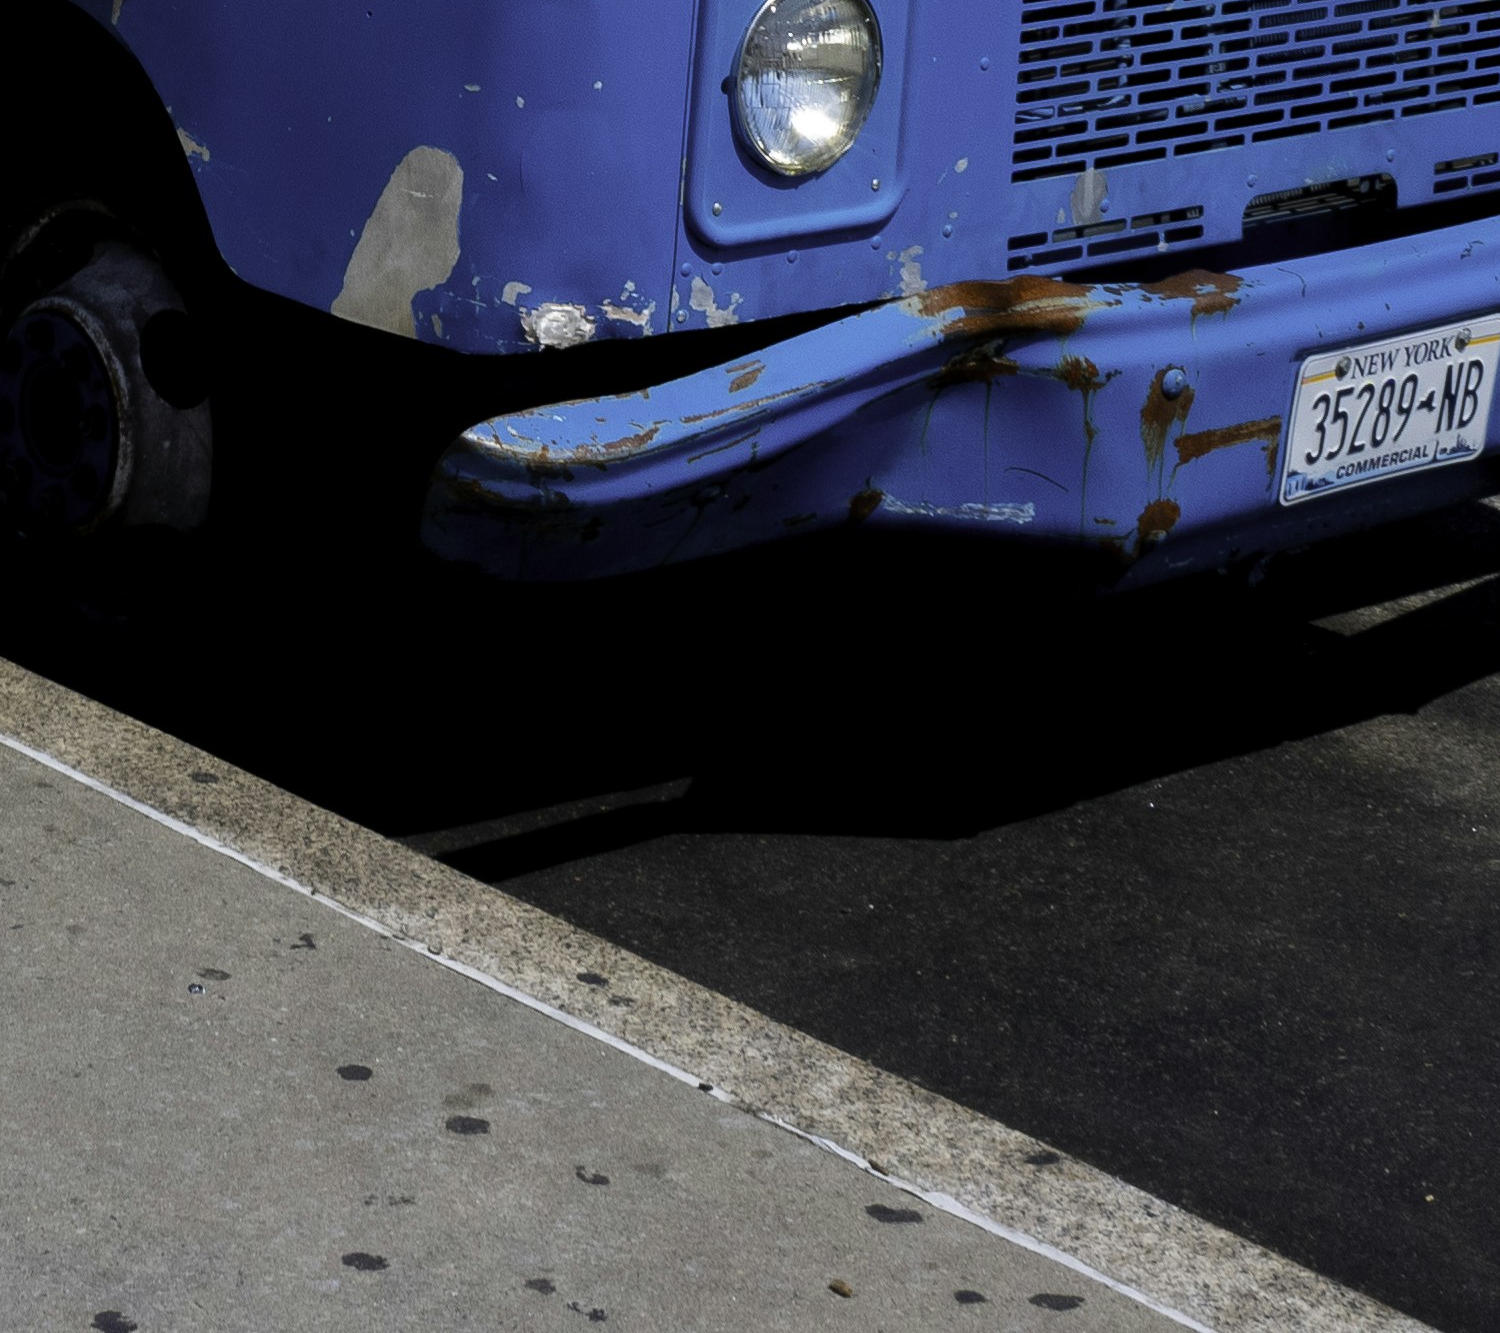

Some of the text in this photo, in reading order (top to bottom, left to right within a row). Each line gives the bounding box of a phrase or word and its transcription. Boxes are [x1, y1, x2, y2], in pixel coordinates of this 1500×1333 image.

[1350, 334, 1453, 379] NEW YORK
[1335, 445, 1429, 480] COMMERCIAL
